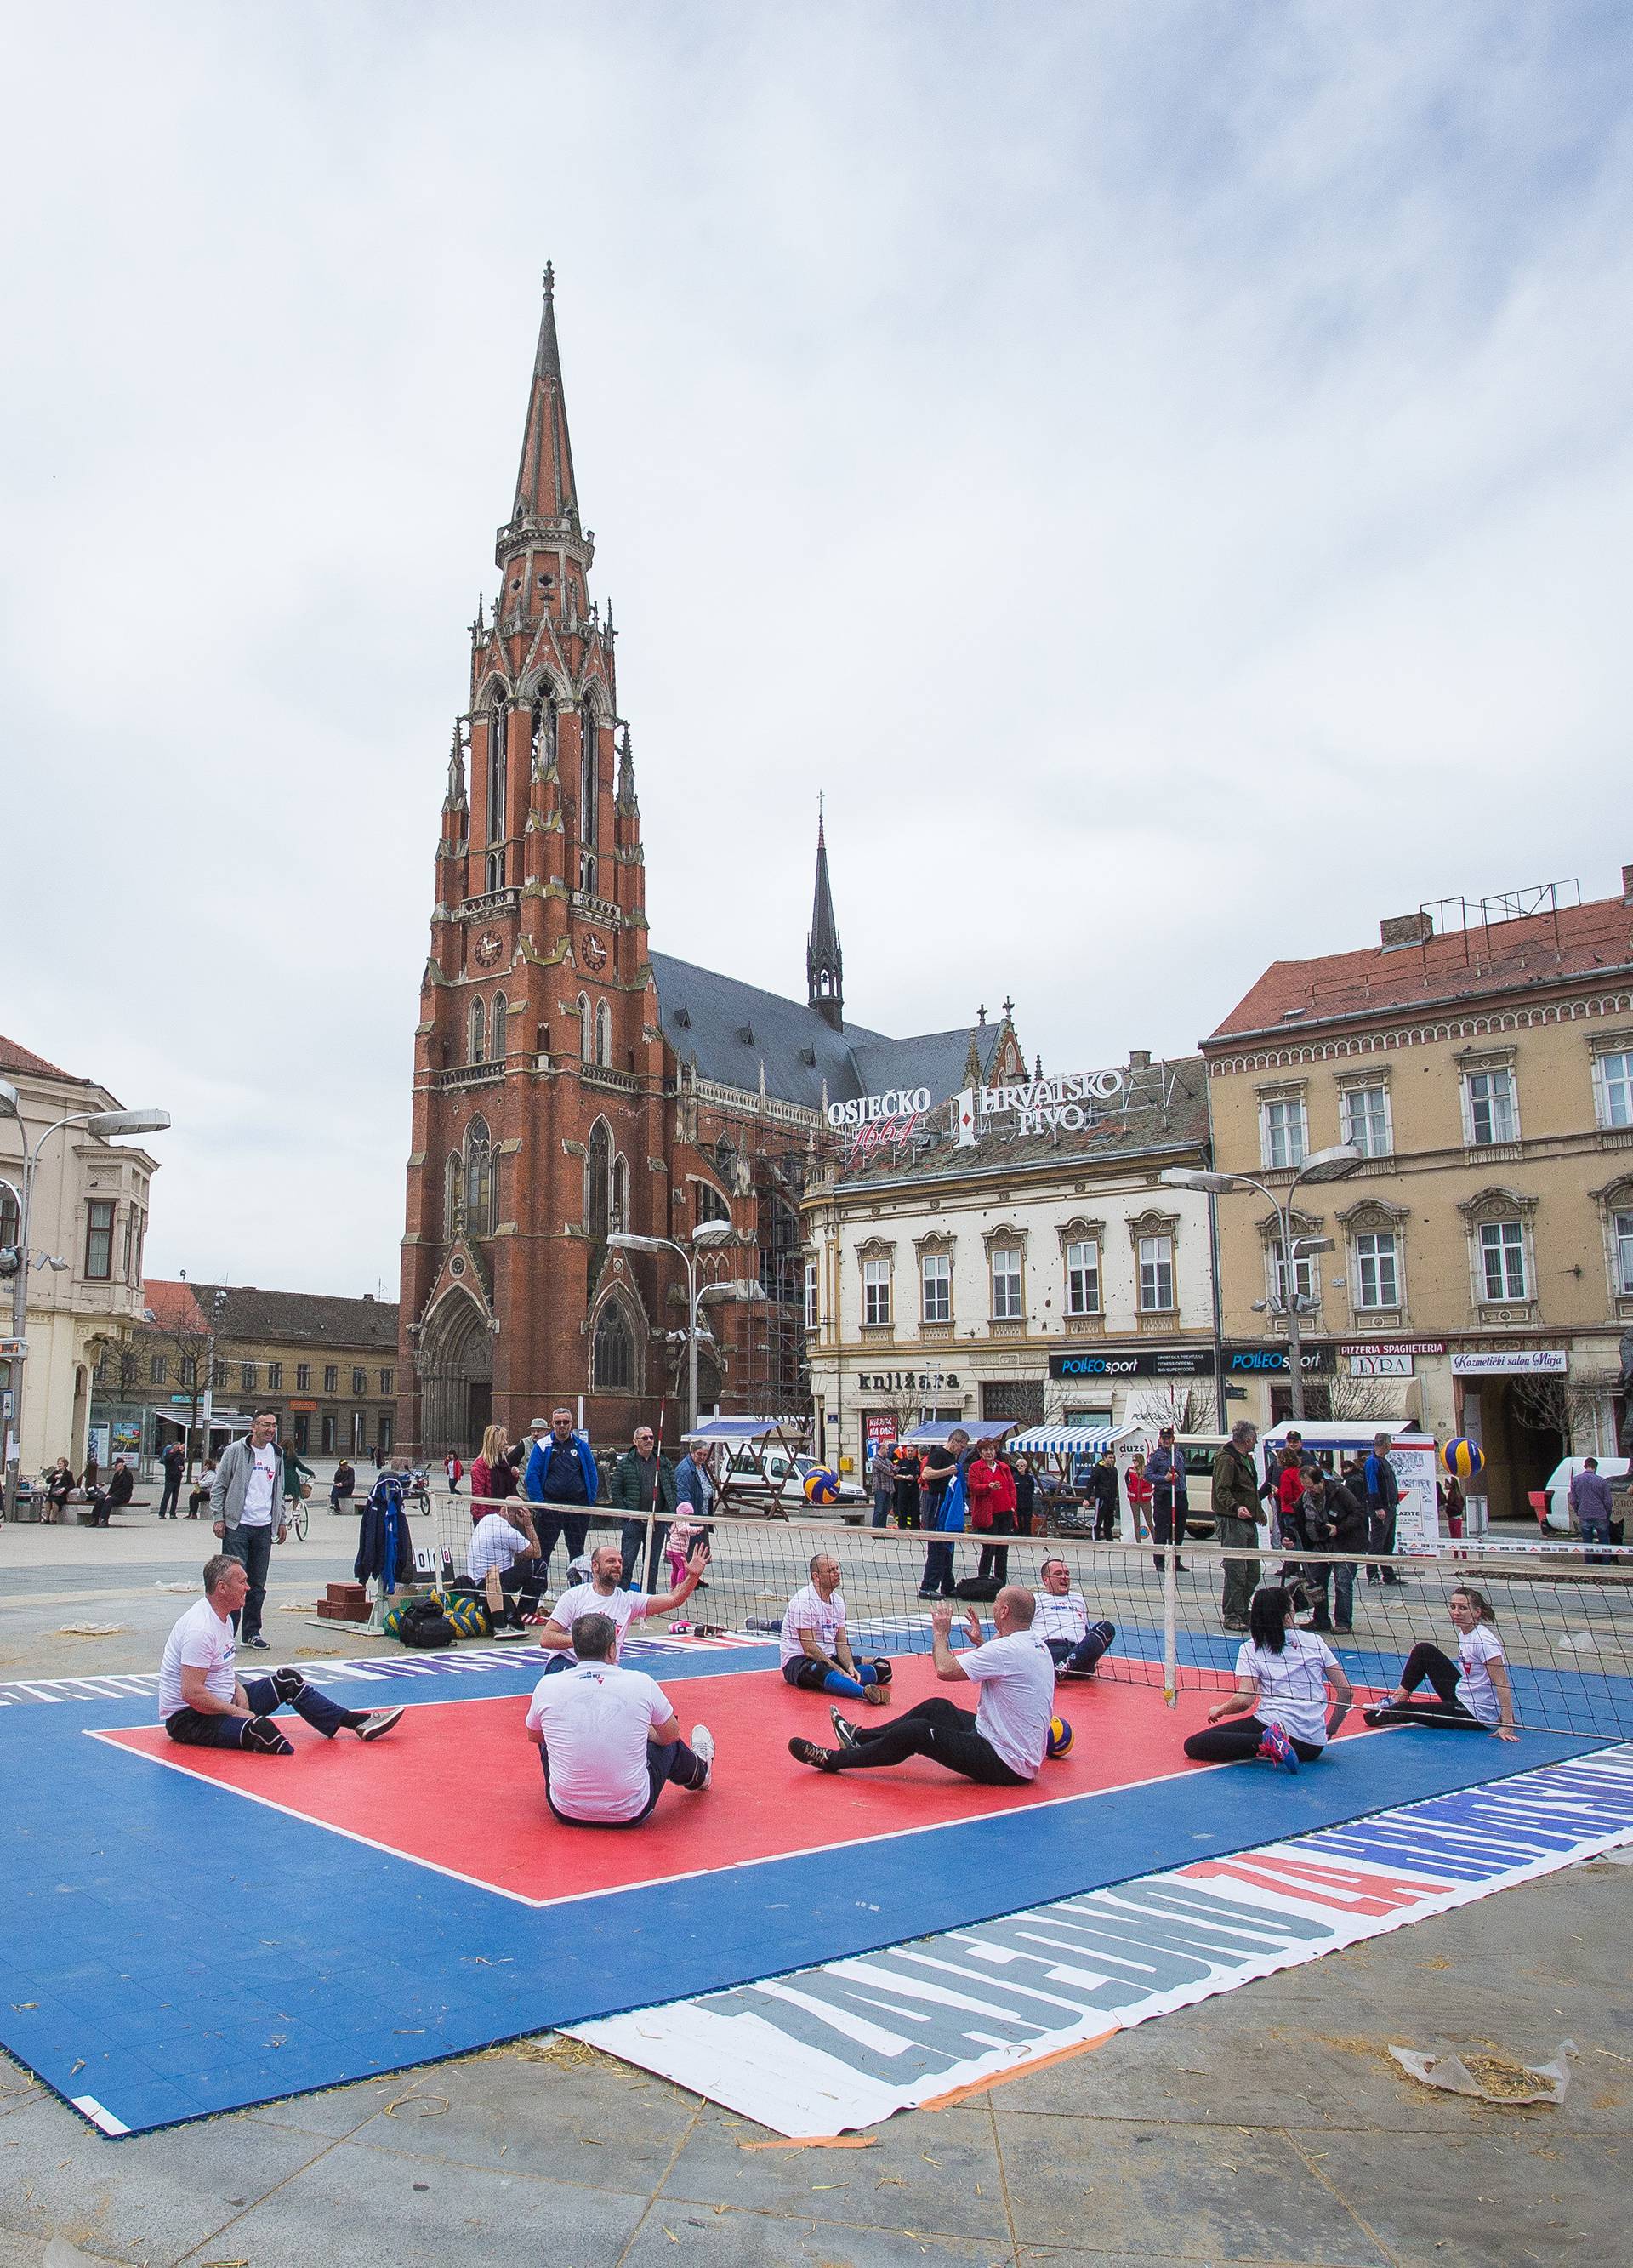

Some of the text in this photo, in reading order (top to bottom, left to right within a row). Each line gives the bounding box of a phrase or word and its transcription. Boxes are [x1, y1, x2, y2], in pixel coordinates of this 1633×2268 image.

[978, 1069, 1124, 1116] HRVATSKO
[828, 1087, 931, 1127] OSJEČKO
[1018, 1104, 1089, 1137] PIVO
[851, 1111, 921, 1155] 1664
[1341, 1343, 1443, 1355] PIZZERIA SPAGHETERIA
[1506, 1354, 1530, 1366] salon
[1532, 1352, 1562, 1367] Mirja
[1359, 1356, 1406, 1375] LYRA
[858, 1372, 960, 1393] knjižara
[869, 1427, 879, 1436] NA
[1119, 1443, 1145, 1453] duzs
[690, 1880, 1334, 2071] ZAJEDNO
[1174, 1852, 1456, 1917] ZA
